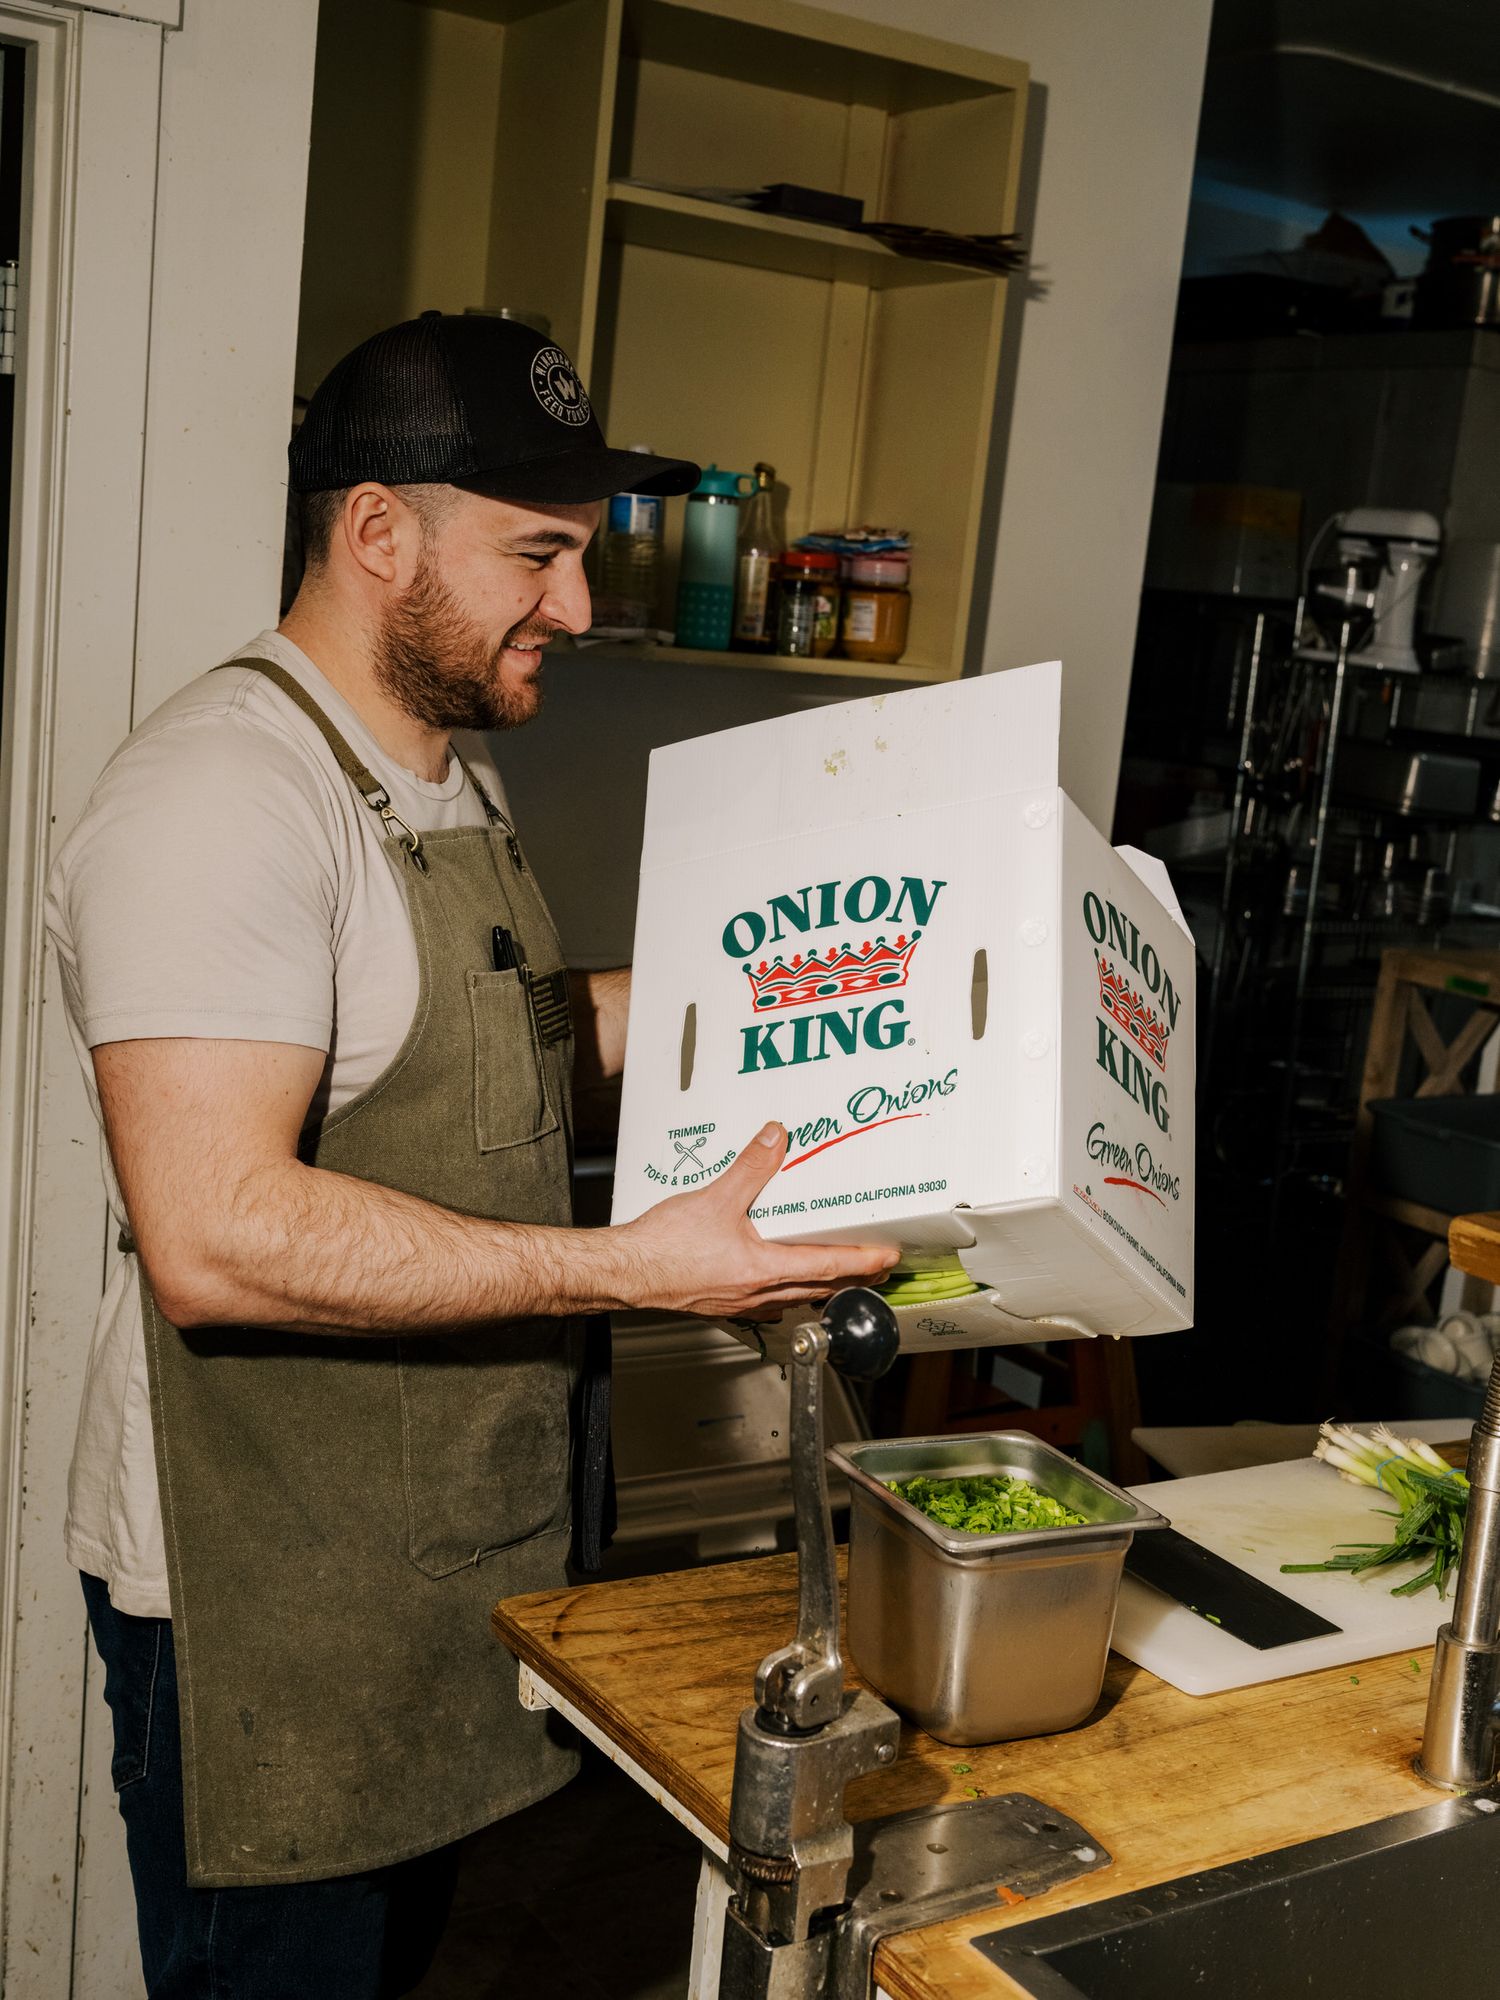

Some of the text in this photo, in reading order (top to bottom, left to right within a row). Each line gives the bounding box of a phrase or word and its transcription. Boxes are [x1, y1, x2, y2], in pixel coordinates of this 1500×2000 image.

[539, 389, 564, 417] FEED
[722, 875, 948, 959] ONION
[1083, 891, 1182, 1032] ONION
[737, 999, 912, 1075] KING
[1096, 1015, 1170, 1133] KING
[667, 1122, 716, 1140] TRIMMED
[785, 1068, 958, 1154] reen Onions
[643, 1149, 737, 1186] TOPS & BOTTOMS
[771, 1201, 808, 1216] FARMS,
[810, 1193, 852, 1210] OXNARD
[854, 1184, 916, 1203] CALIFORNIA
[917, 1179, 947, 1194] 93030
[1086, 1121, 1134, 1177] Green
[1134, 1142, 1180, 1201] Onions
